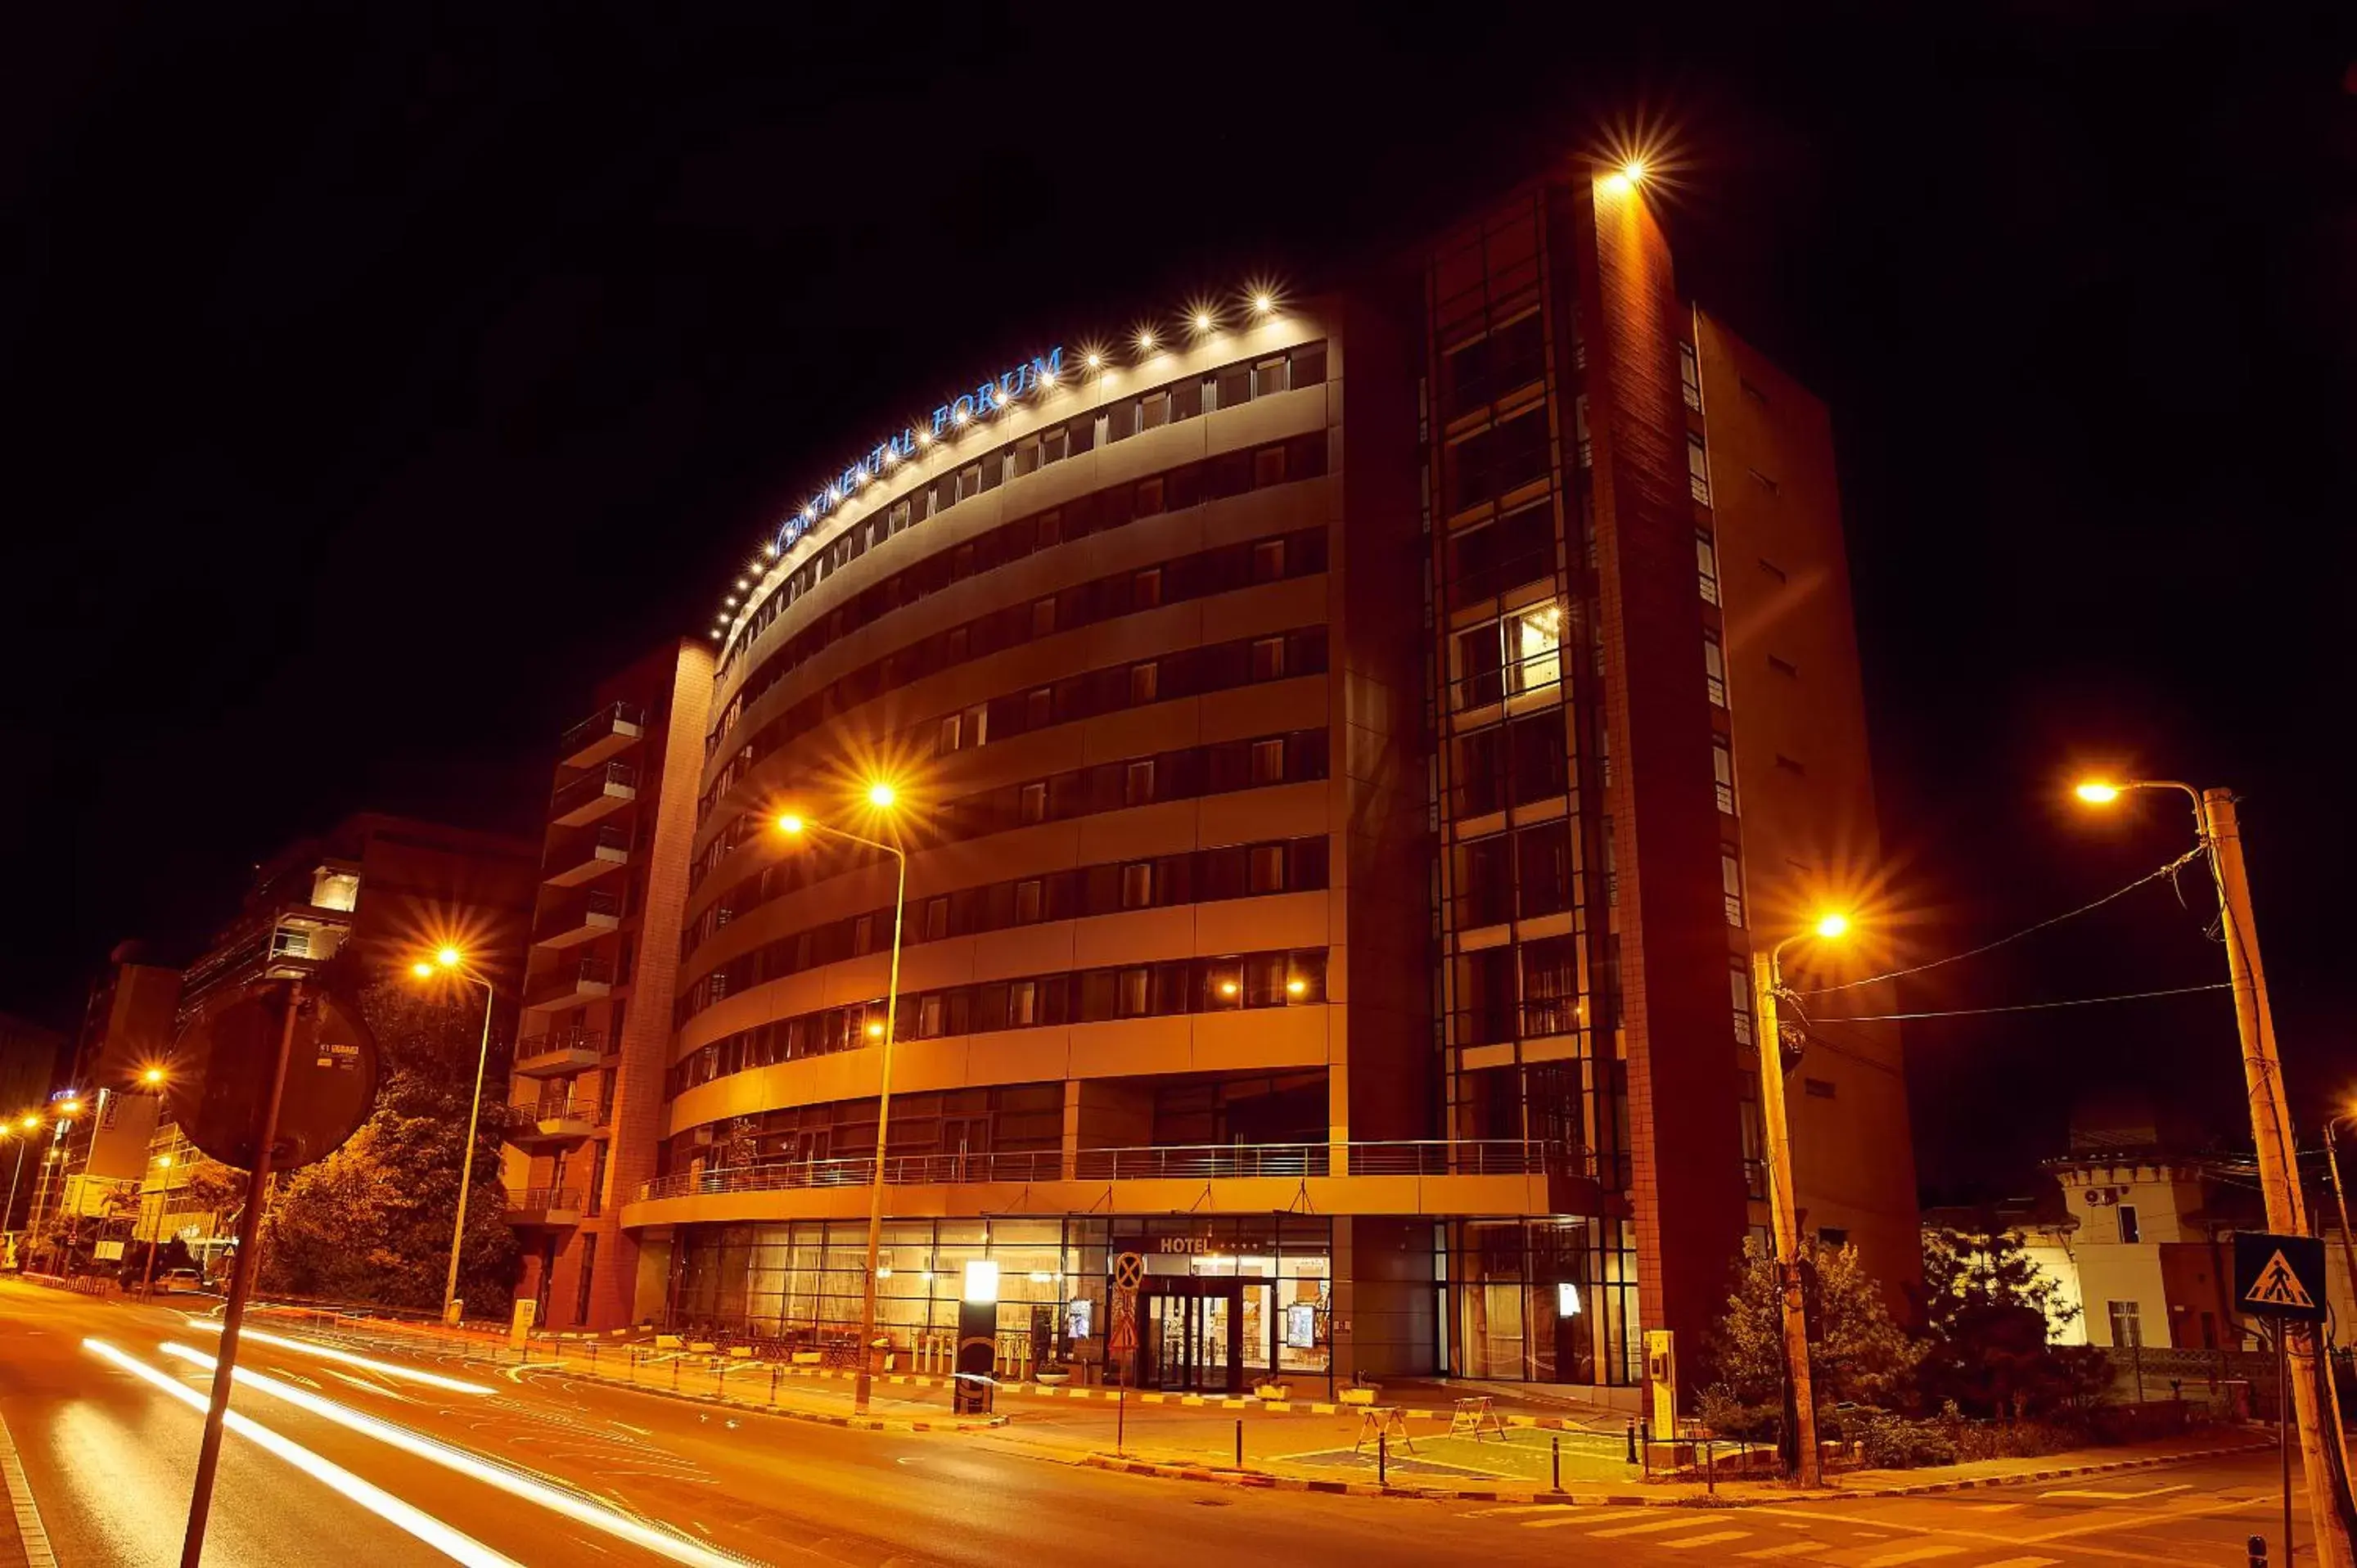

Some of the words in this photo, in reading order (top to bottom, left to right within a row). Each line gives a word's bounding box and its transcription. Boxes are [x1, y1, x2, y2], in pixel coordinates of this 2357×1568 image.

[777, 428, 915, 556] CONTINENTAL
[931, 346, 1062, 436] FORUM
[1160, 1237, 1212, 1254] HOTEL
